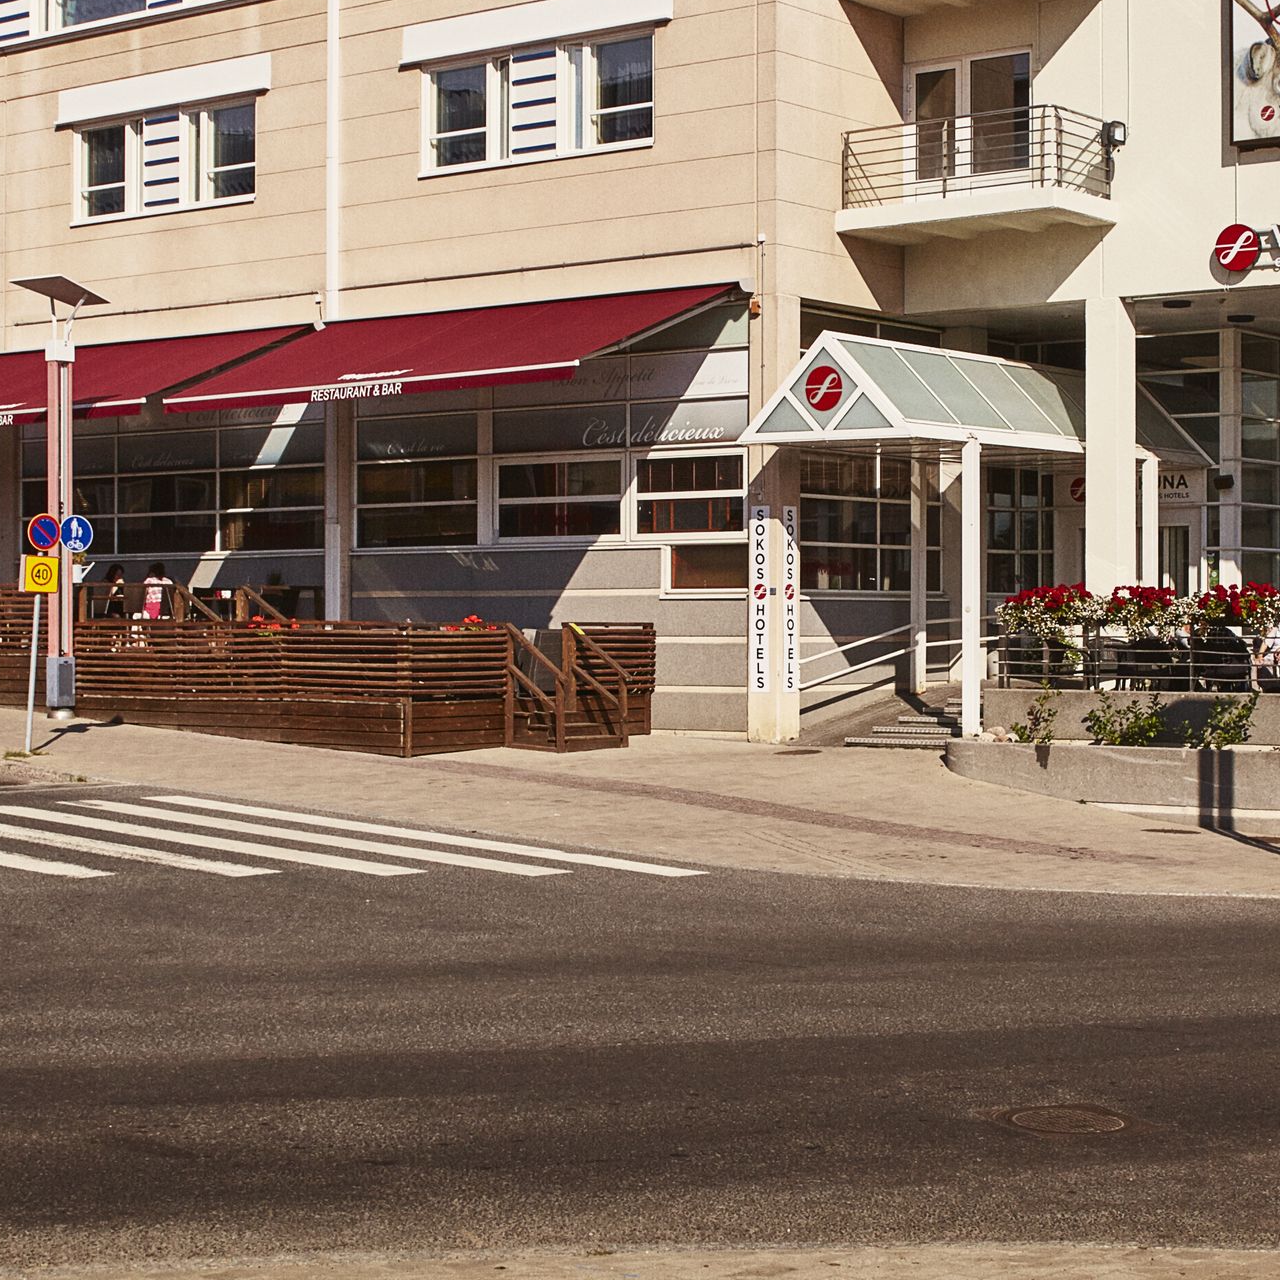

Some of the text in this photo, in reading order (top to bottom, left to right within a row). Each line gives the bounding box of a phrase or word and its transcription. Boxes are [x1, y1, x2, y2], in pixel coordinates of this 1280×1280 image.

[310, 382, 402, 402] RESTAURANT & BAR
[34, 568, 49, 581] 40
[755, 509, 765, 689] SOKOS HOTELS
[786, 509, 795, 689] SOKOS HOTELS
